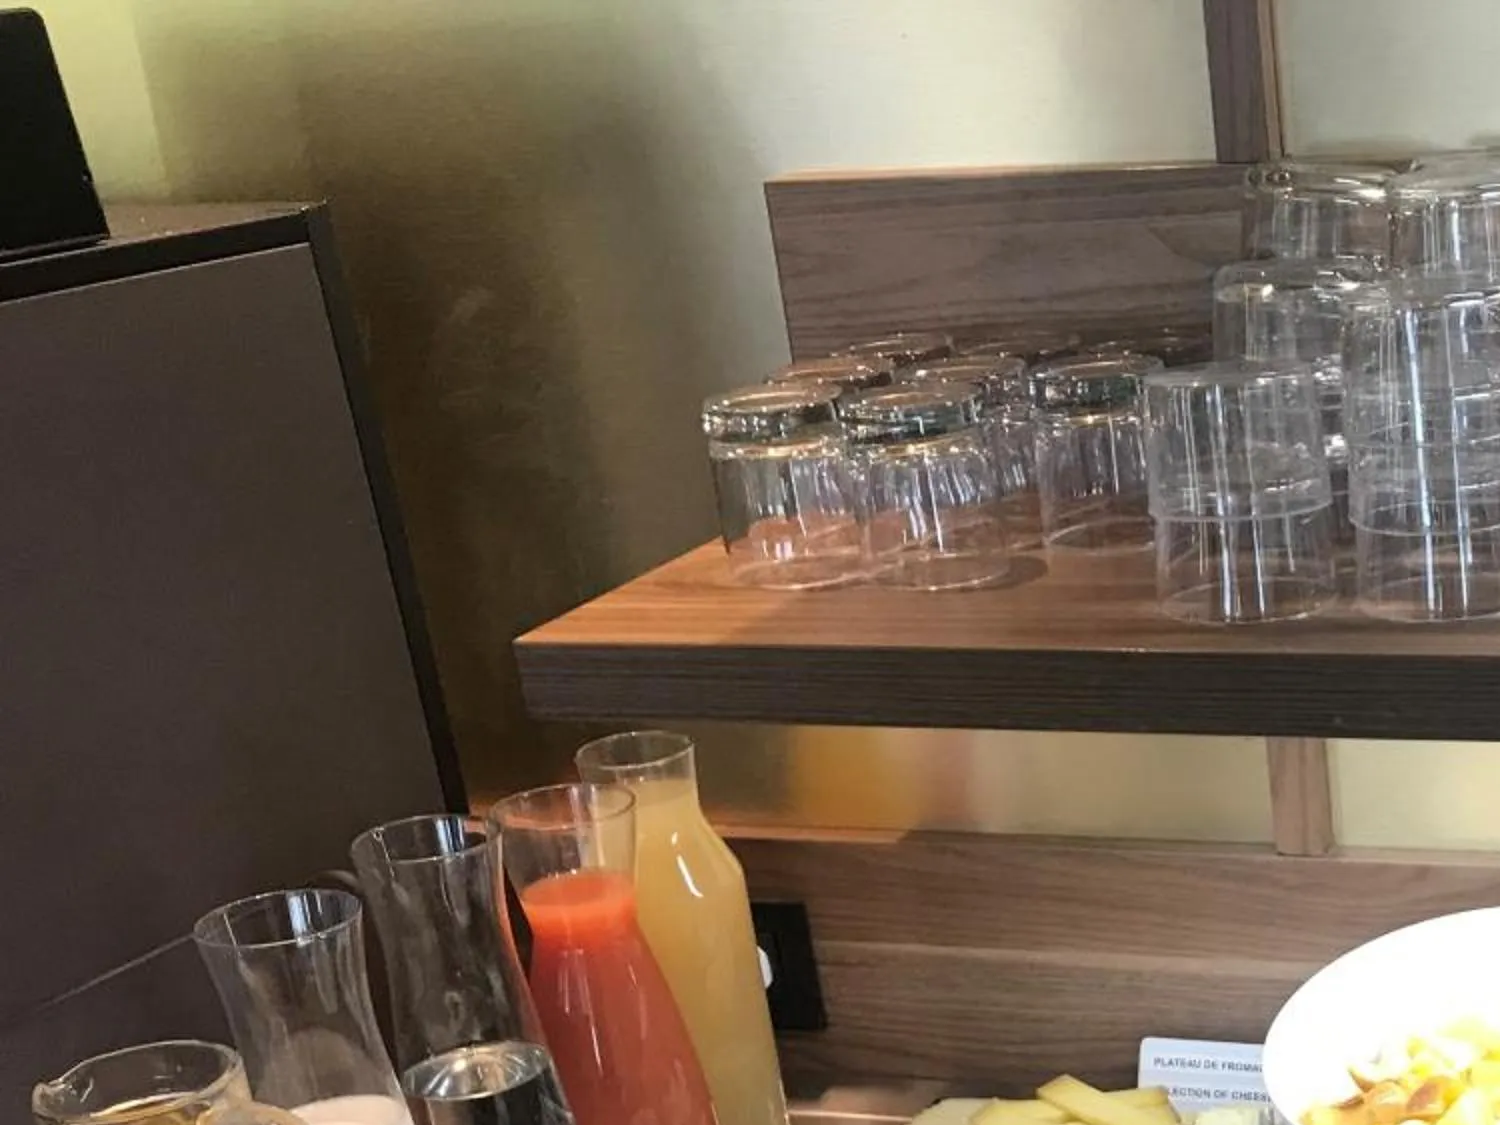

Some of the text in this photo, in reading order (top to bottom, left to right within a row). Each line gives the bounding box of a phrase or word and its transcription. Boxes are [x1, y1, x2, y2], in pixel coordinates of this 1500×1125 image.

[1153, 1057, 1200, 1069] PLATEAU
[1203, 1059, 1217, 1069] DE
[1213, 1089, 1227, 1099] OF
